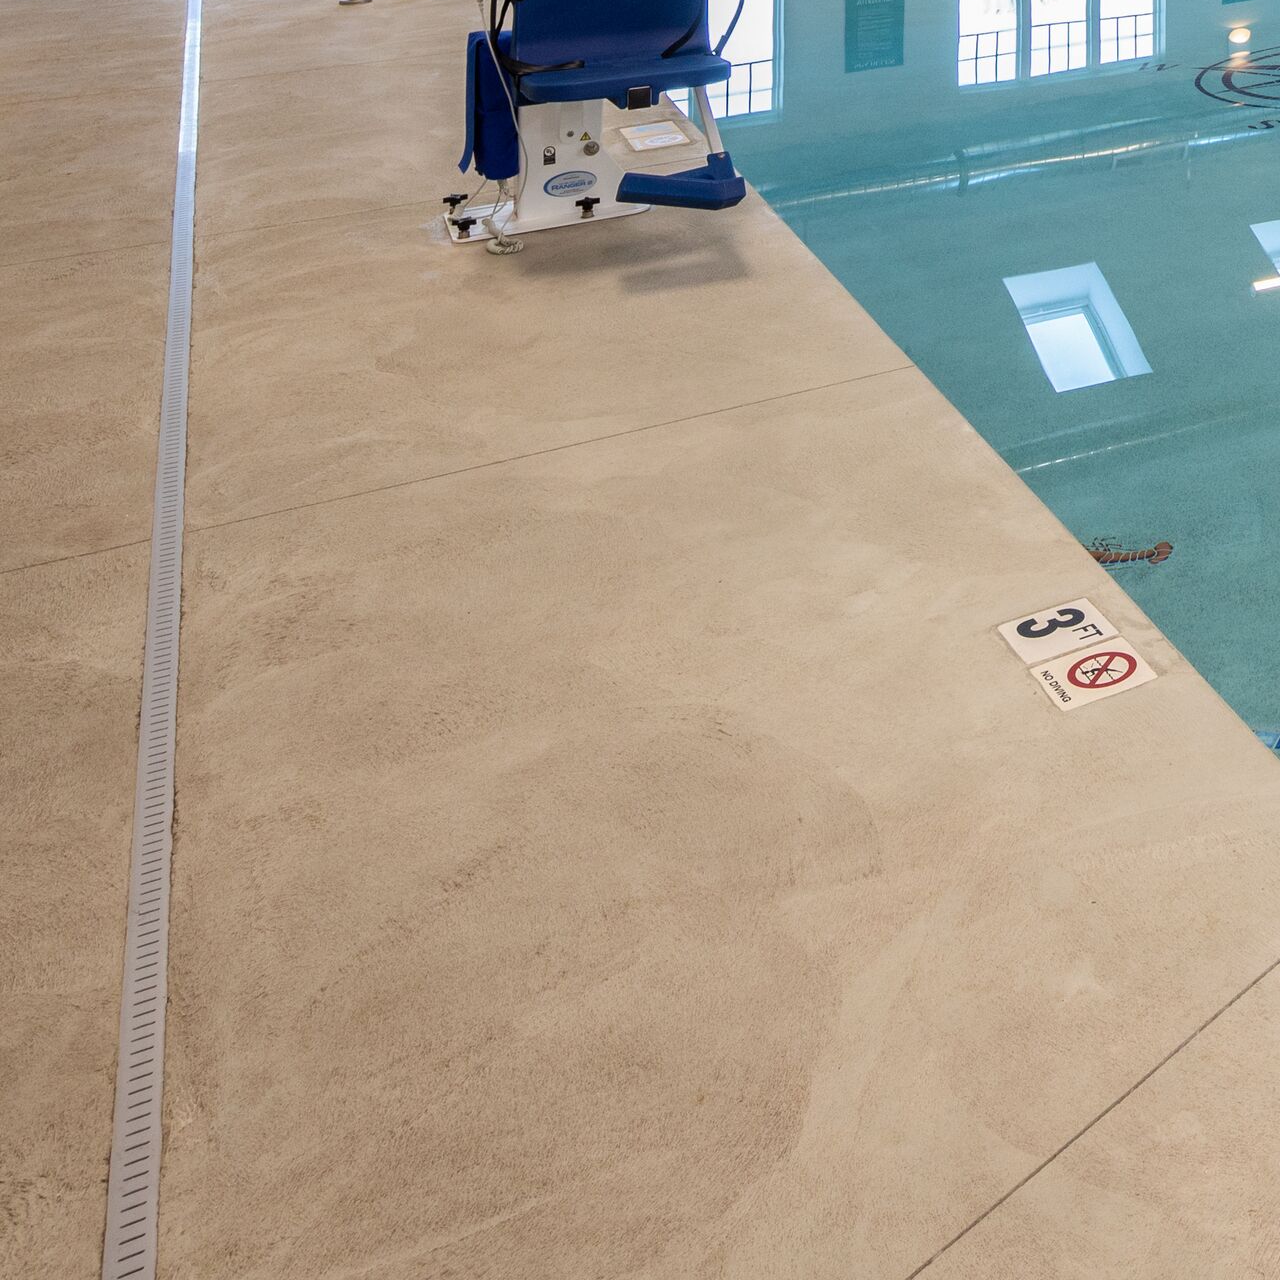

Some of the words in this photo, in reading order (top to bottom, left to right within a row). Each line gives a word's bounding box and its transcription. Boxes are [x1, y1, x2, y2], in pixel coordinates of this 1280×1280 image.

[551, 180, 586, 190] RANGER
[1016, 607, 1086, 638] 3
[1072, 623, 1104, 640] FT
[1040, 670, 1054, 681] NO
[1049, 680, 1072, 703] DIVING
